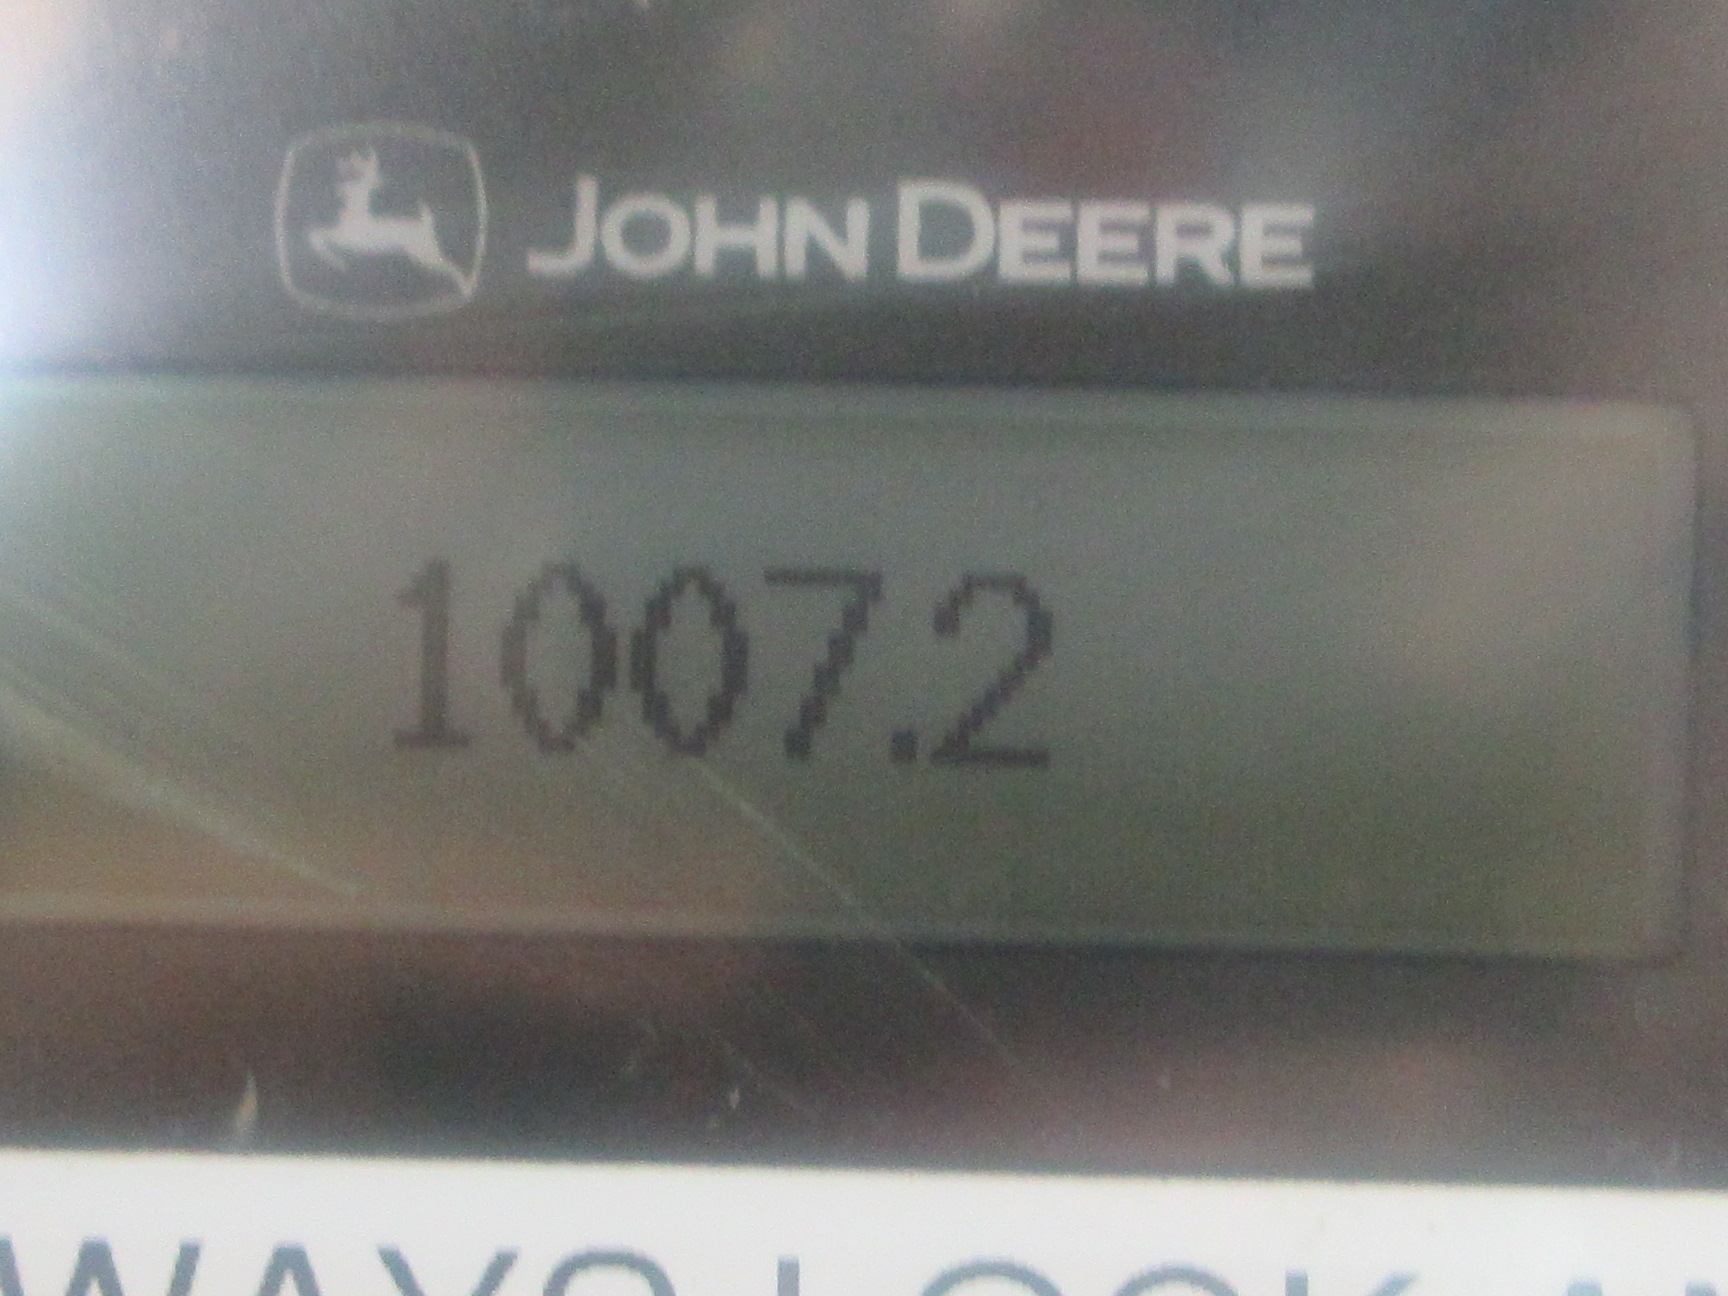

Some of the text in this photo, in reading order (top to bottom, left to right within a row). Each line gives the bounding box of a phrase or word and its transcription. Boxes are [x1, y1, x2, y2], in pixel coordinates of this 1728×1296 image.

[527, 177, 1316, 289] JOHN DEERE
[393, 559, 1054, 768] 1007.2
